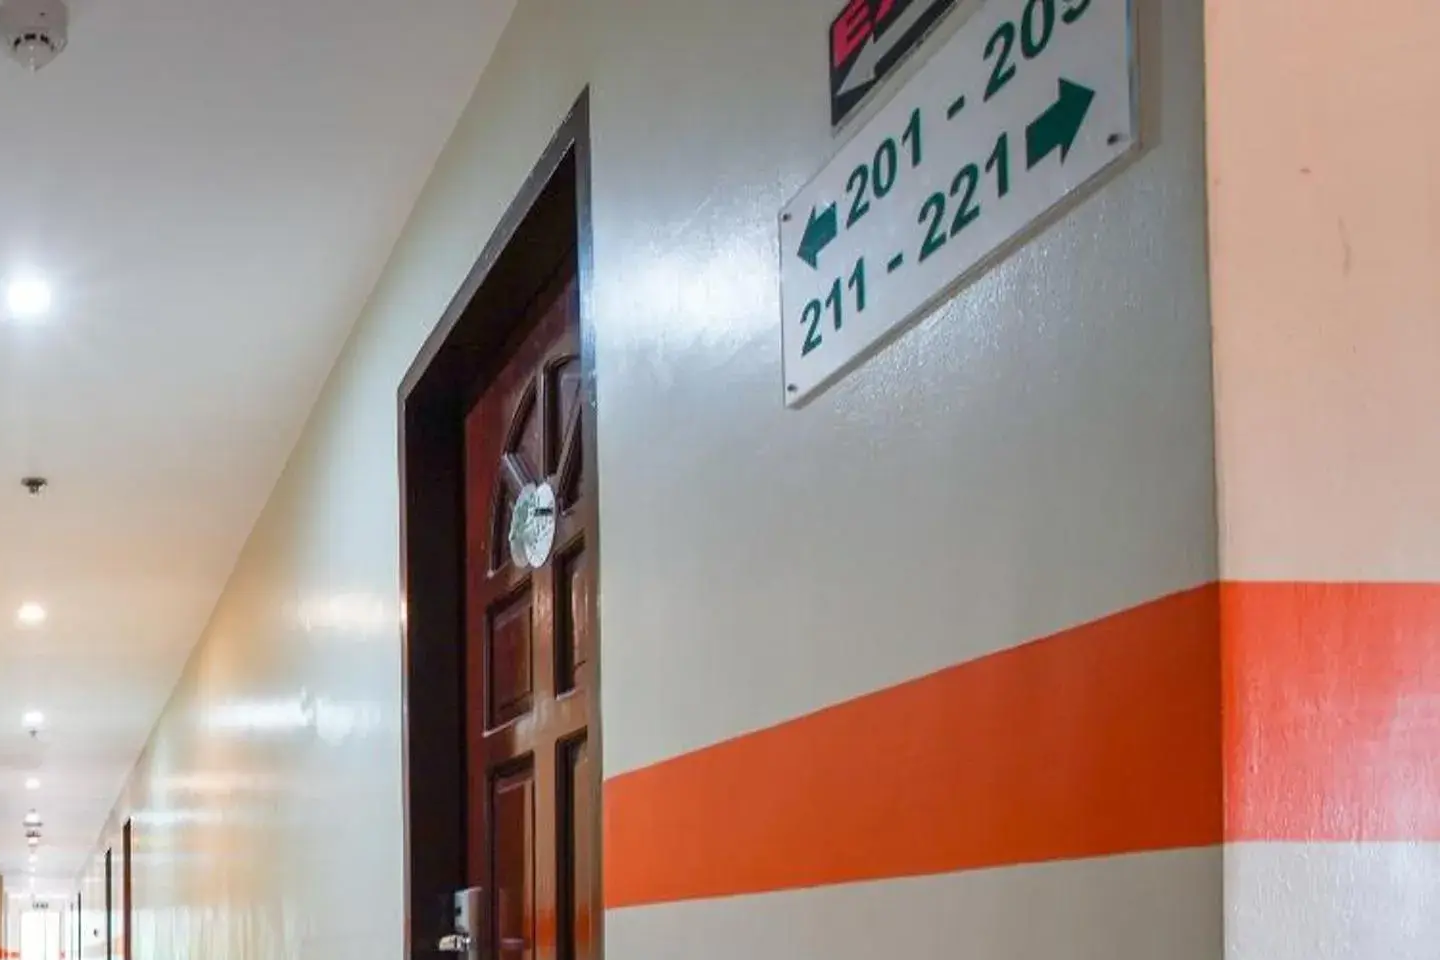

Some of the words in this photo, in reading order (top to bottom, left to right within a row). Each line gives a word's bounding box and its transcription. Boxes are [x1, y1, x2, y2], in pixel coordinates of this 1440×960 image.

[799, 256, 866, 358] 211
[917, 131, 1010, 263] 221
[845, 107, 922, 230] 201
